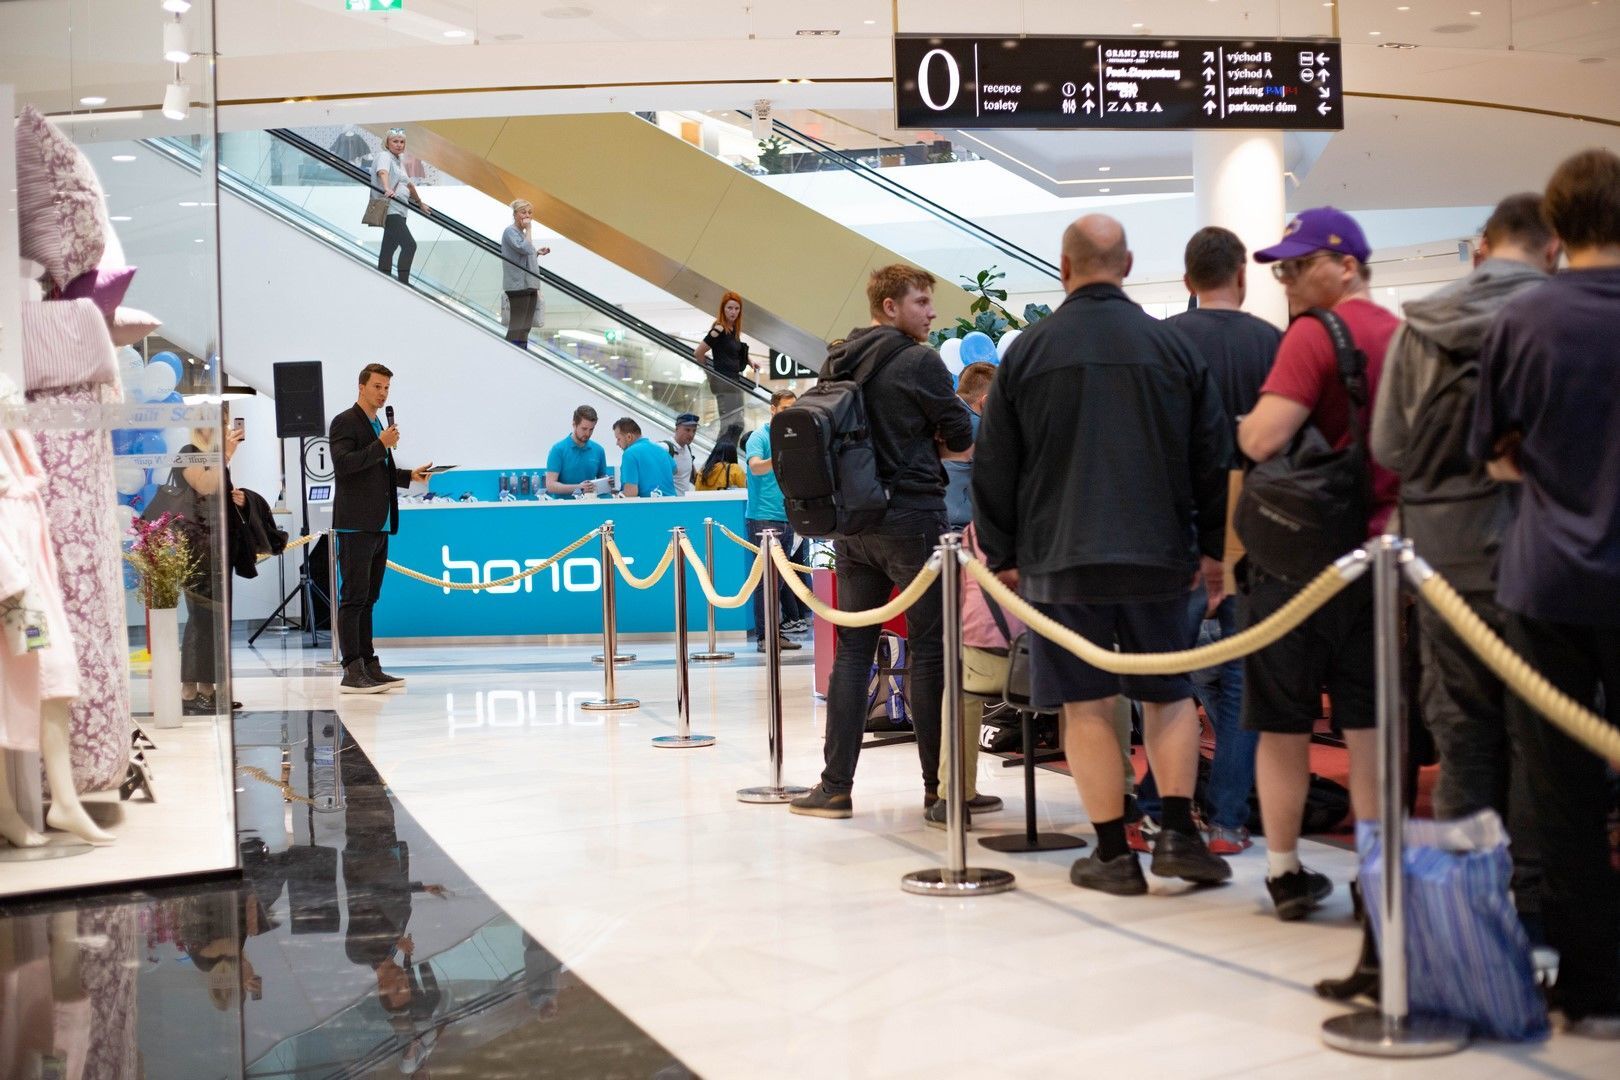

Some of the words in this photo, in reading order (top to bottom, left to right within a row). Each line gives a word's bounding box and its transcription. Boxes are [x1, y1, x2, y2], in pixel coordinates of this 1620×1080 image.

[1105, 49, 1138, 58] GRAND
[1139, 50, 1180, 59] KITCHEN
[1227, 51, 1262, 64] východ
[1264, 51, 1272, 62] B
[918, 49, 960, 110] 0
[1227, 68, 1263, 81] východ
[1265, 68, 1273, 79] A
[983, 84, 1022, 96] recepce
[1228, 85, 1264, 97] parking
[984, 99, 1019, 113] toalety
[1107, 101, 1164, 112] ZARA
[1228, 101, 1274, 114] parkovací
[978, 724, 1001, 748] KE
